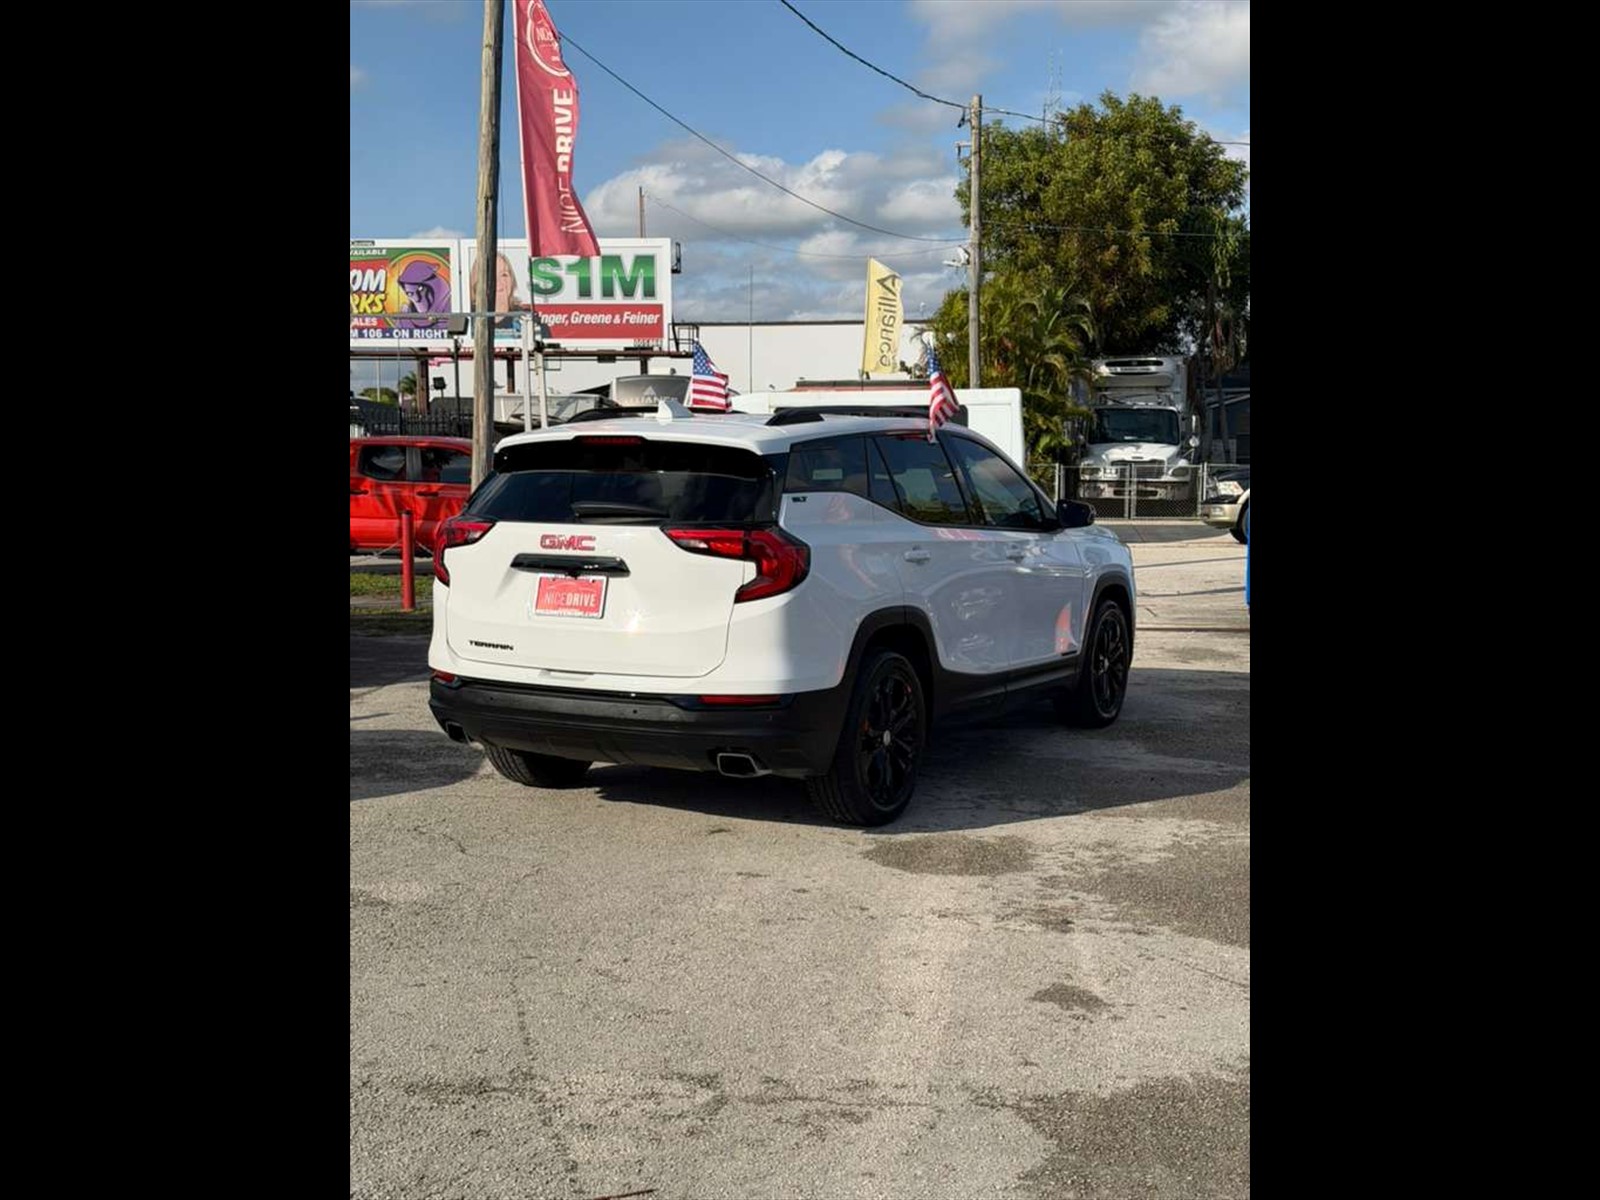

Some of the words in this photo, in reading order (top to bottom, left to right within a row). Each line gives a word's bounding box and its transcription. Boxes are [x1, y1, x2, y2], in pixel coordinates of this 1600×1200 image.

[570, 311, 613, 324] Greene
[613, 314, 622, 324] &
[622, 311, 661, 324] Feiner
[362, 329, 383, 338] 106
[392, 329, 409, 338] ON
[413, 329, 448, 338] RIGHT
[539, 534, 596, 551] GMC
[468, 639, 514, 651] TERRAIN
